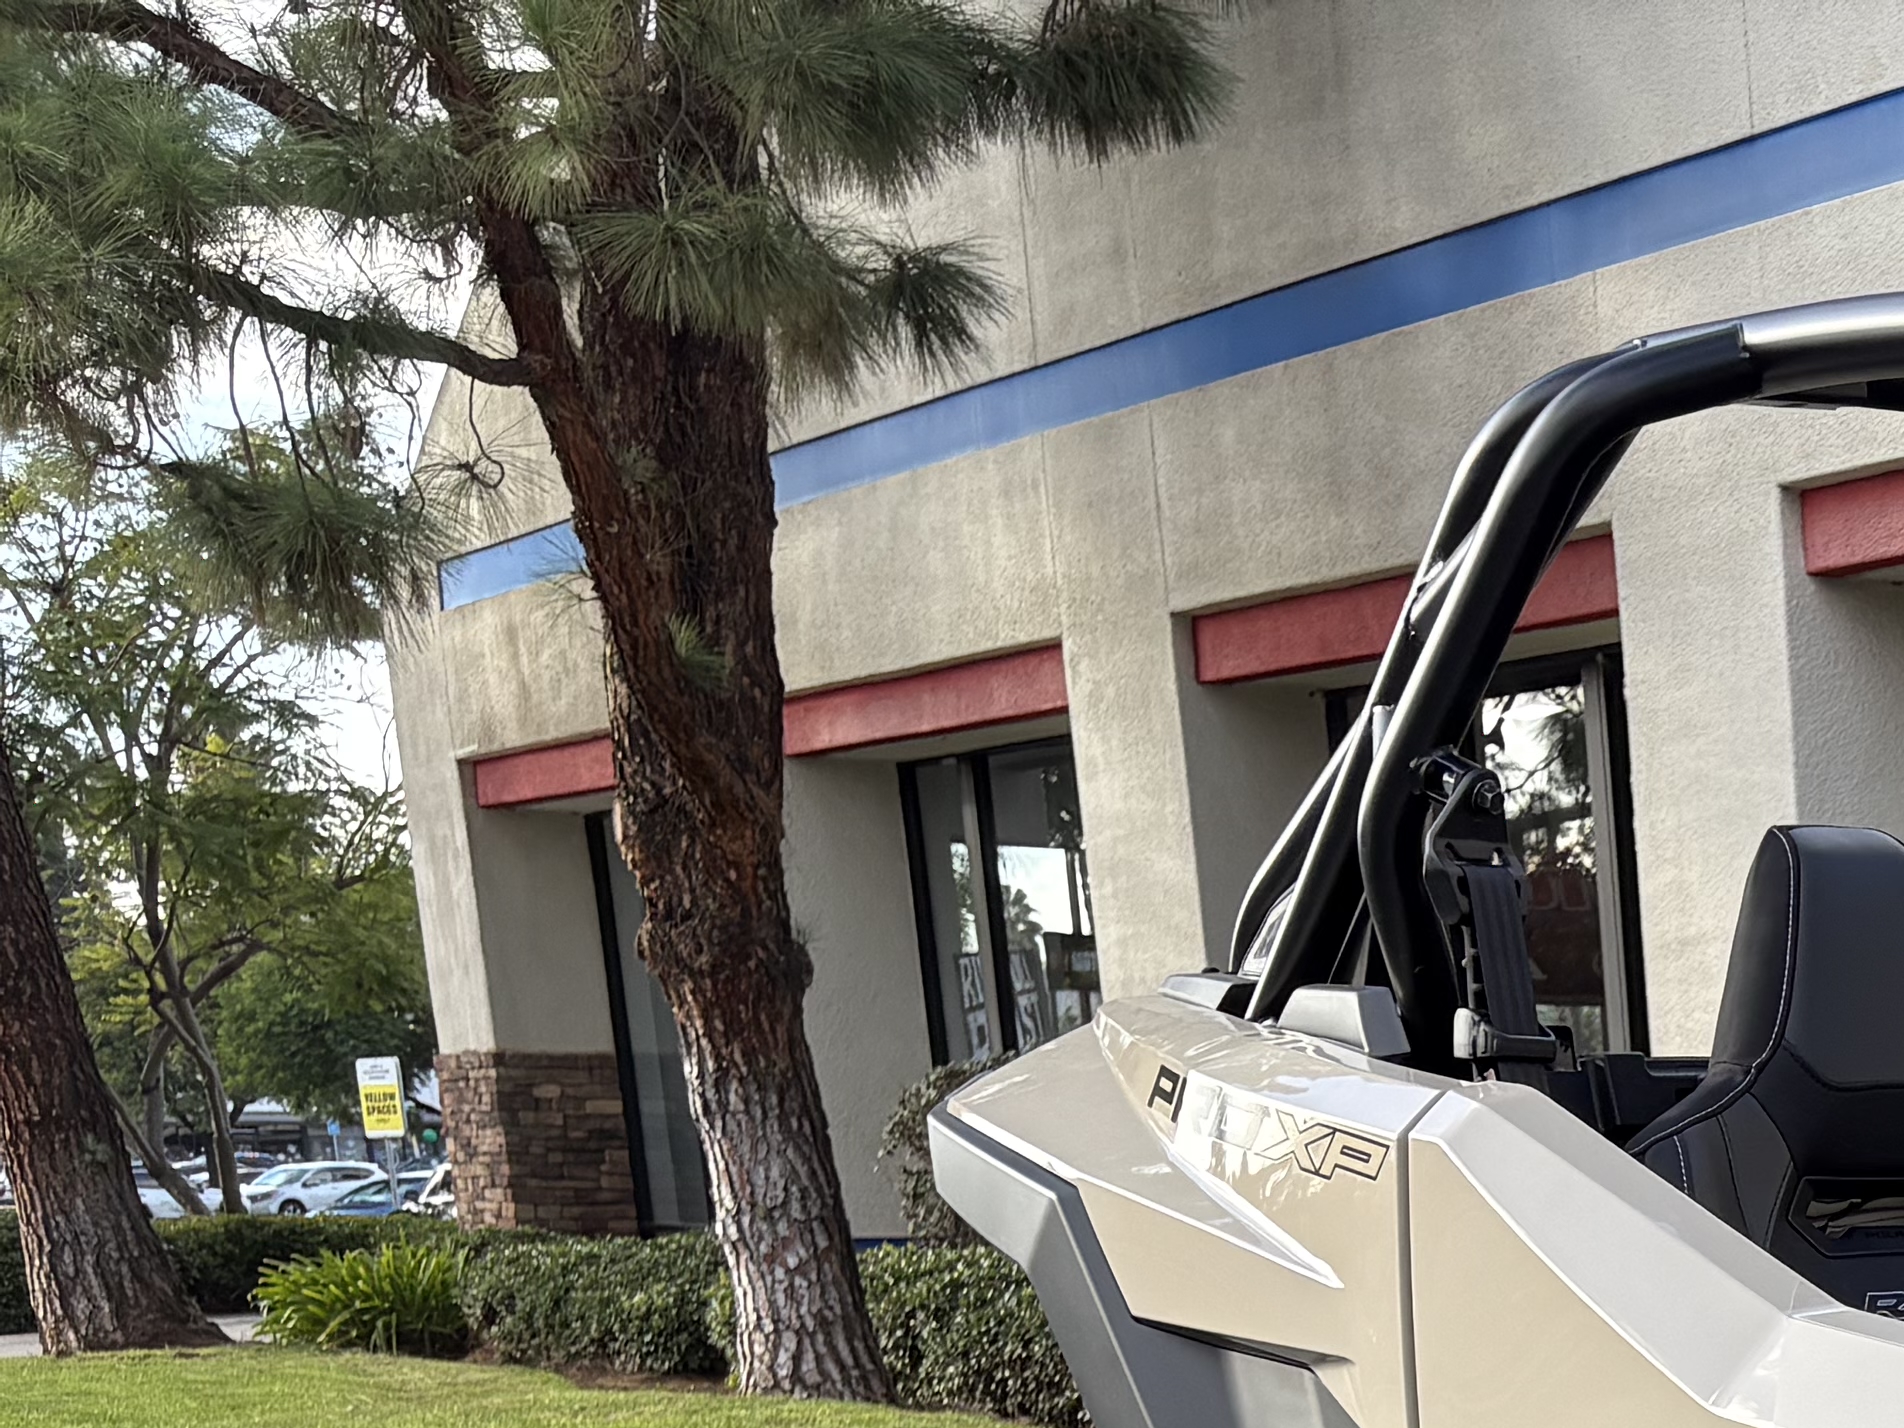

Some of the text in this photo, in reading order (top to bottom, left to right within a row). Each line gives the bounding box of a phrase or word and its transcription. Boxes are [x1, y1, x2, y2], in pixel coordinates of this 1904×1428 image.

[364, 1091, 397, 1103] YELLOW
[366, 1103, 398, 1116] SPACES
[1254, 1108, 1390, 1180] XP
